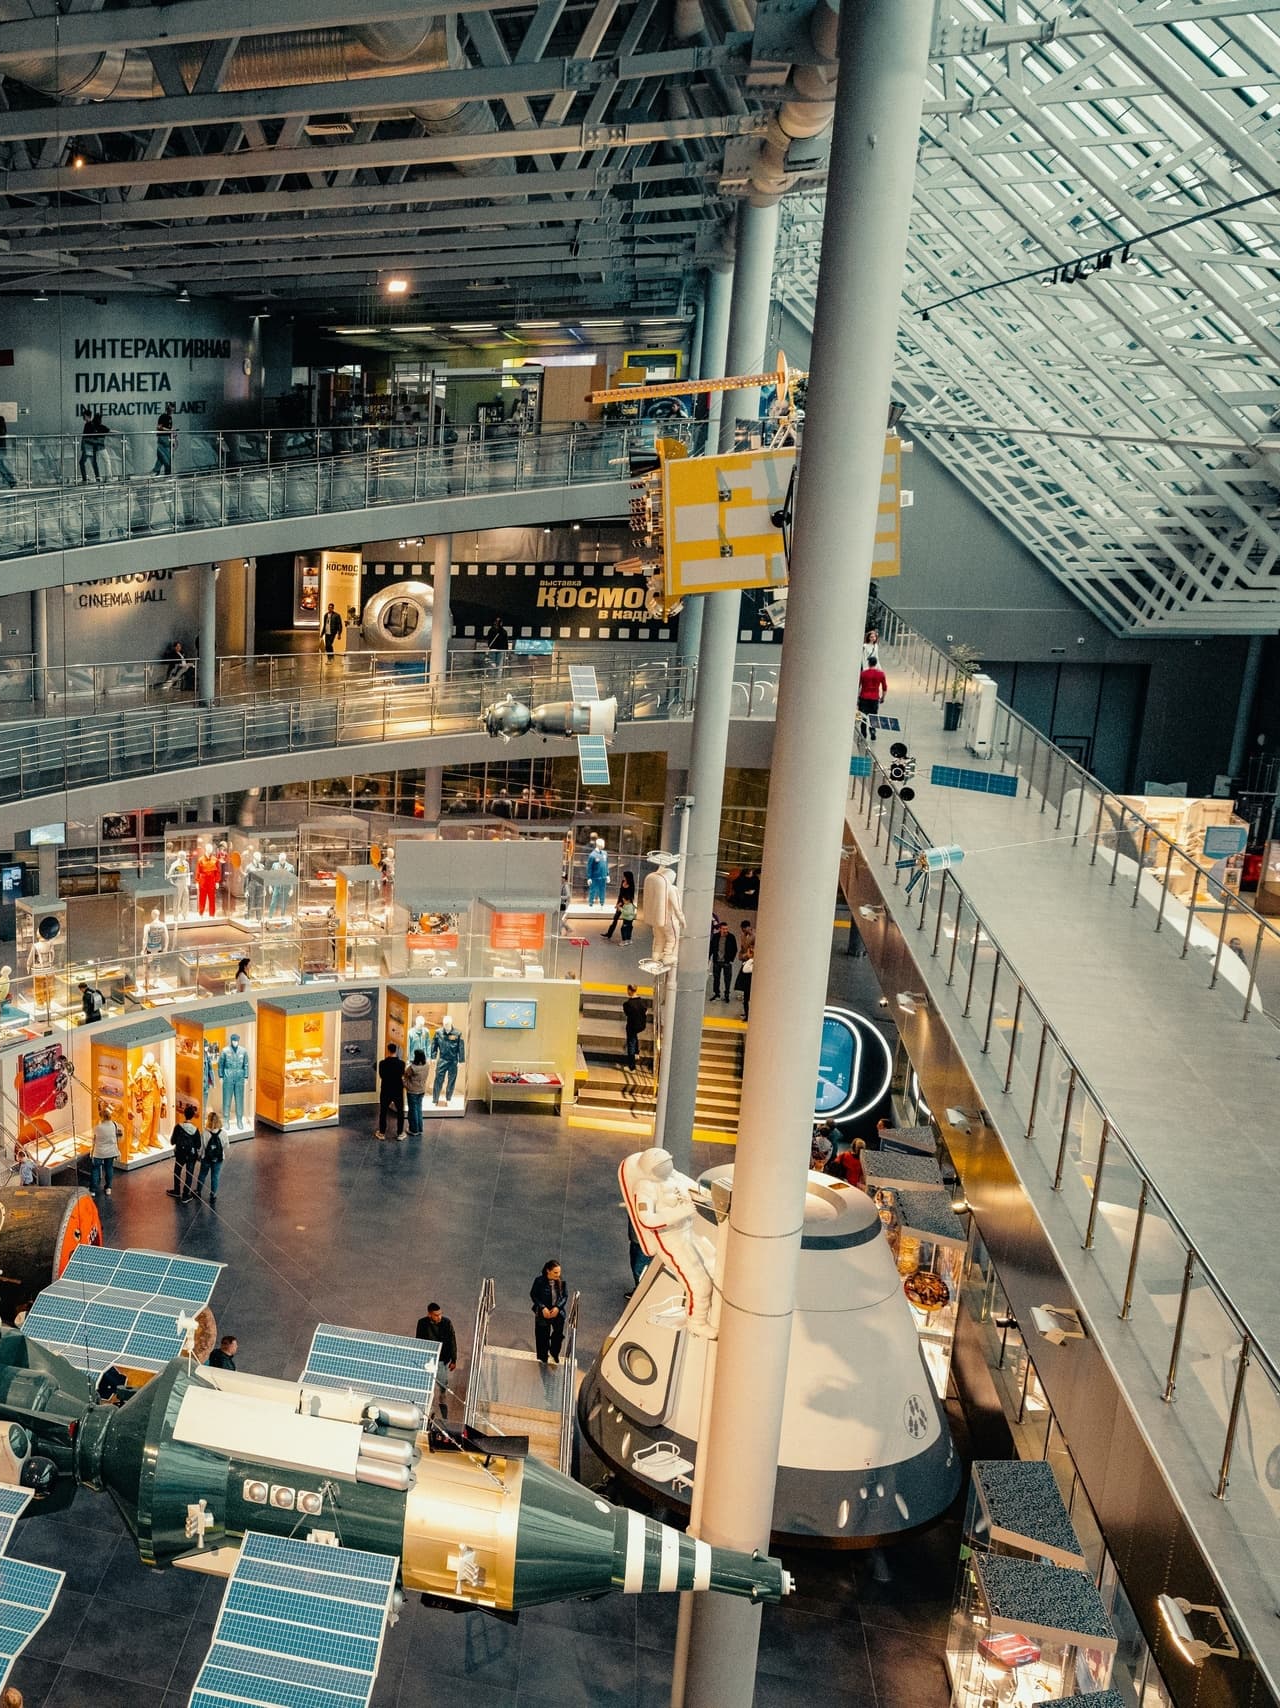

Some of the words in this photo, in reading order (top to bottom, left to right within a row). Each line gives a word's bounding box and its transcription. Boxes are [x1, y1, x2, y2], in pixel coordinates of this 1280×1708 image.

[75, 338, 231, 359] ИНТЕРАКТИВНАЯ
[75, 372, 171, 393] ПЛАНЕТА
[75, 402, 161, 417] INTERACTIVE
[326, 563, 359, 573] КОСМОС
[539, 579, 582, 587] выставка
[79, 591, 132, 608] CINEMA
[134, 588, 167, 605] HALL
[598, 609, 609, 620] в
